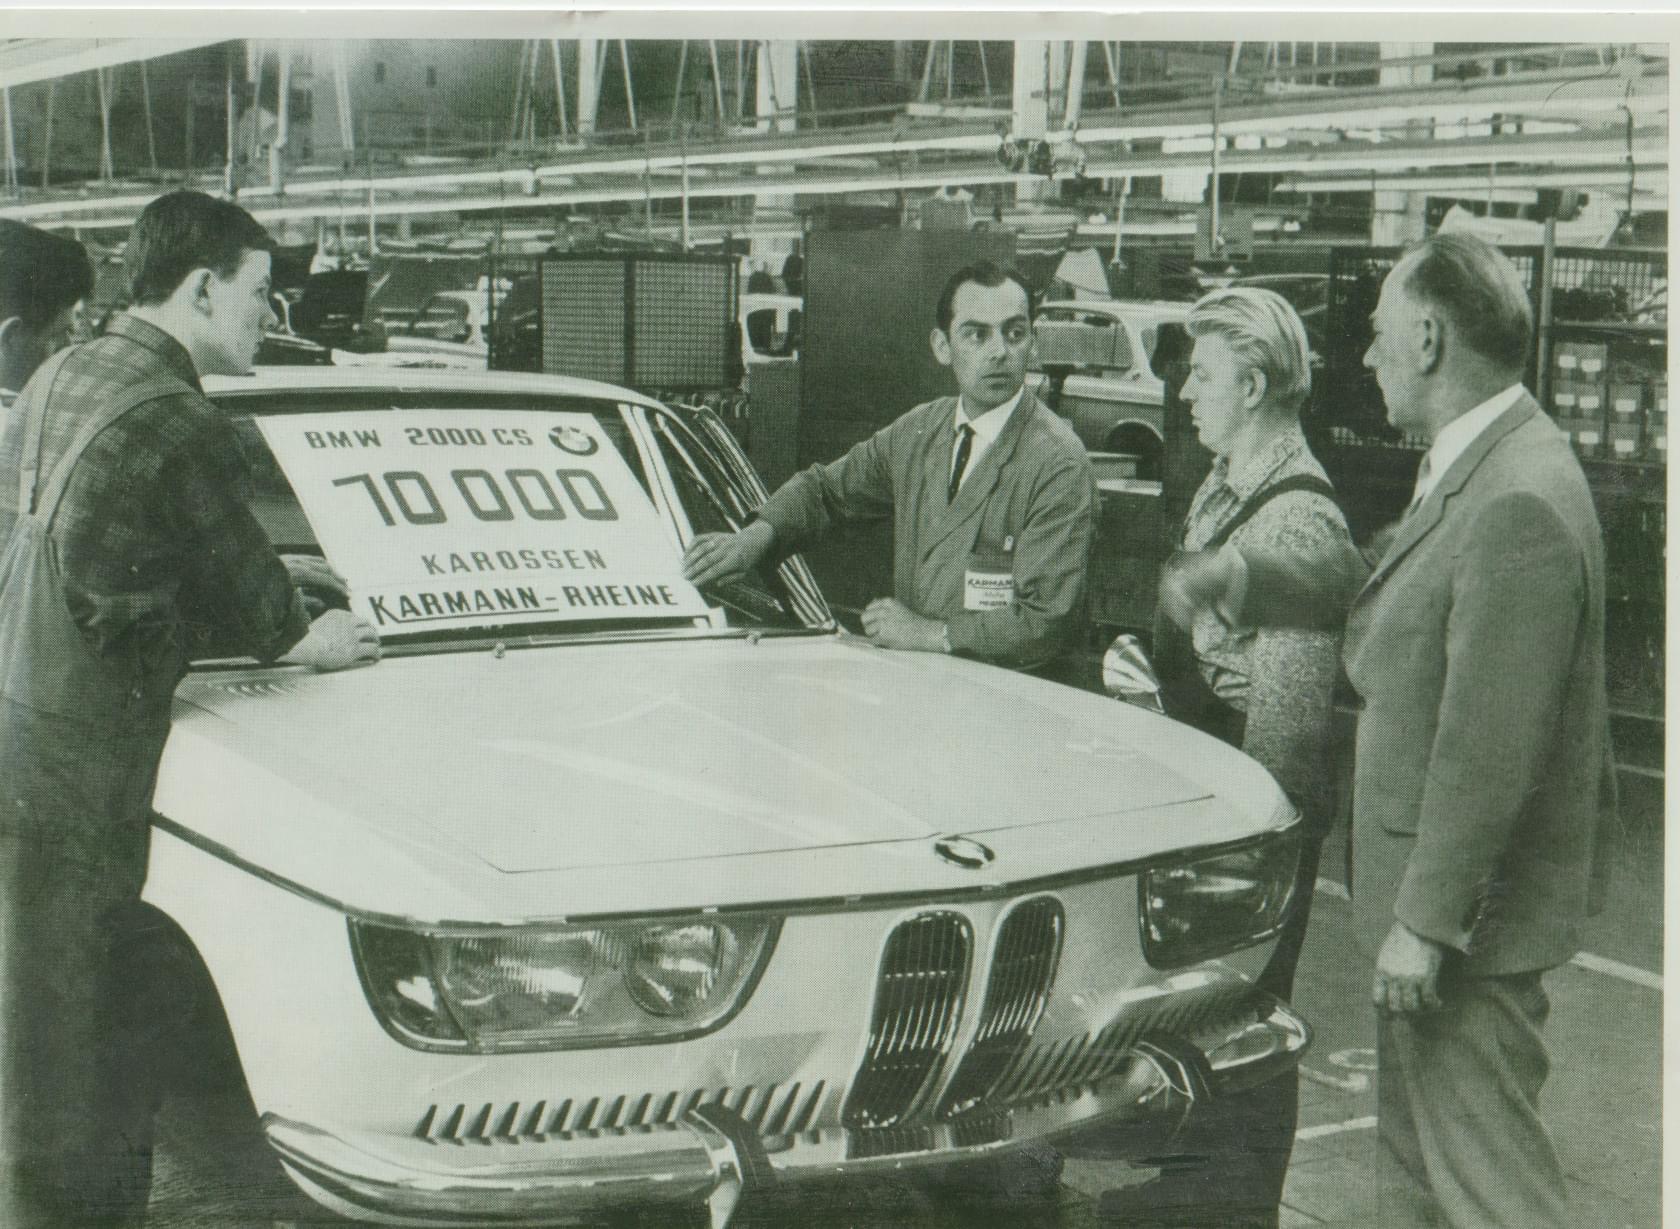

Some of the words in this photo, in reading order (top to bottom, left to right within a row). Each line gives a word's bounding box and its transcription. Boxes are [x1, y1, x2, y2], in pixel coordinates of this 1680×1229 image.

[303, 429, 382, 449] BMW
[403, 427, 488, 446] 2000
[491, 428, 534, 446] CS
[421, 549, 608, 576] KAROSSEN
